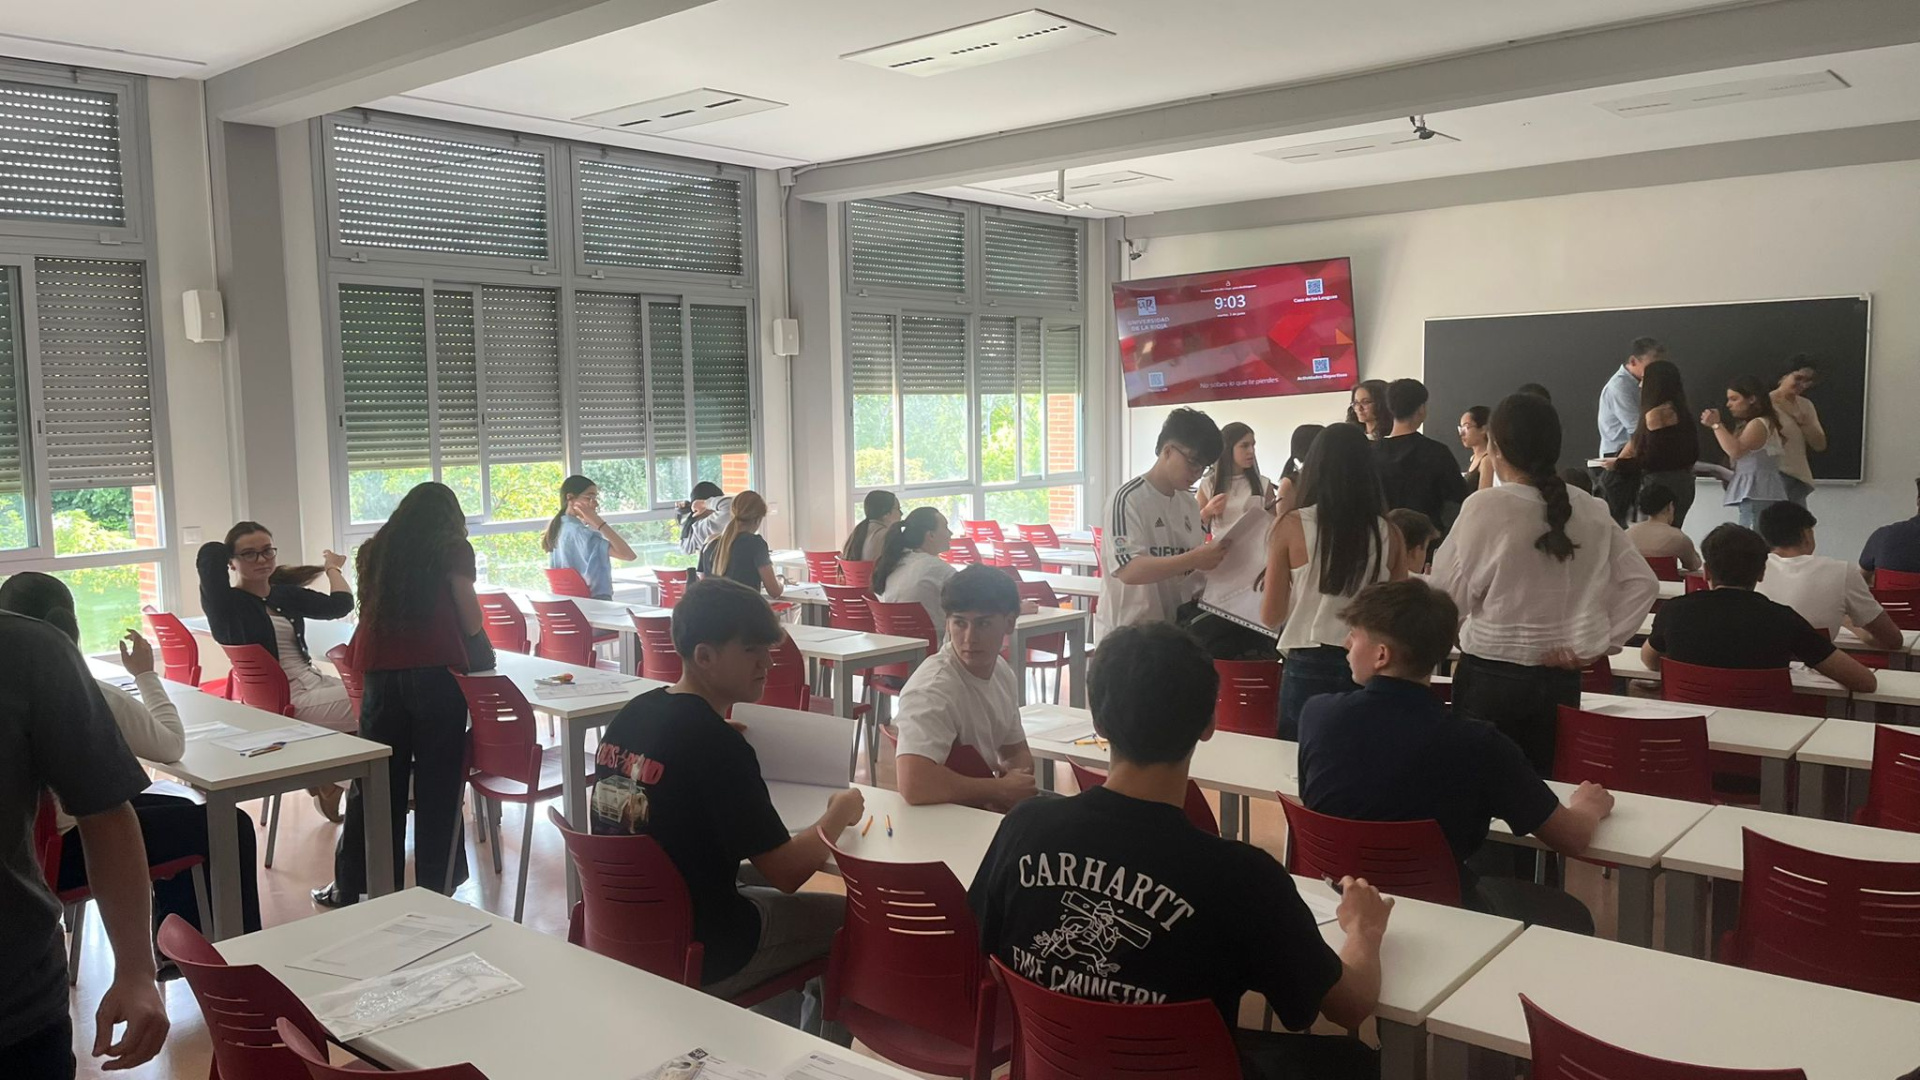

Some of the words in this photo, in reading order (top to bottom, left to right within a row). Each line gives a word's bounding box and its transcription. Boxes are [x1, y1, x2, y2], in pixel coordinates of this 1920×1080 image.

[1214, 294, 1246, 310] 9:03
[1128, 316, 1170, 326] UNIVERSIDAD
[1150, 323, 1168, 331] RIOJA
[1236, 380, 1247, 388] que
[1255, 376, 1279, 386] pierdes
[1018, 851, 1195, 932] CARHARTT
[1012, 945, 1046, 986] FINE
